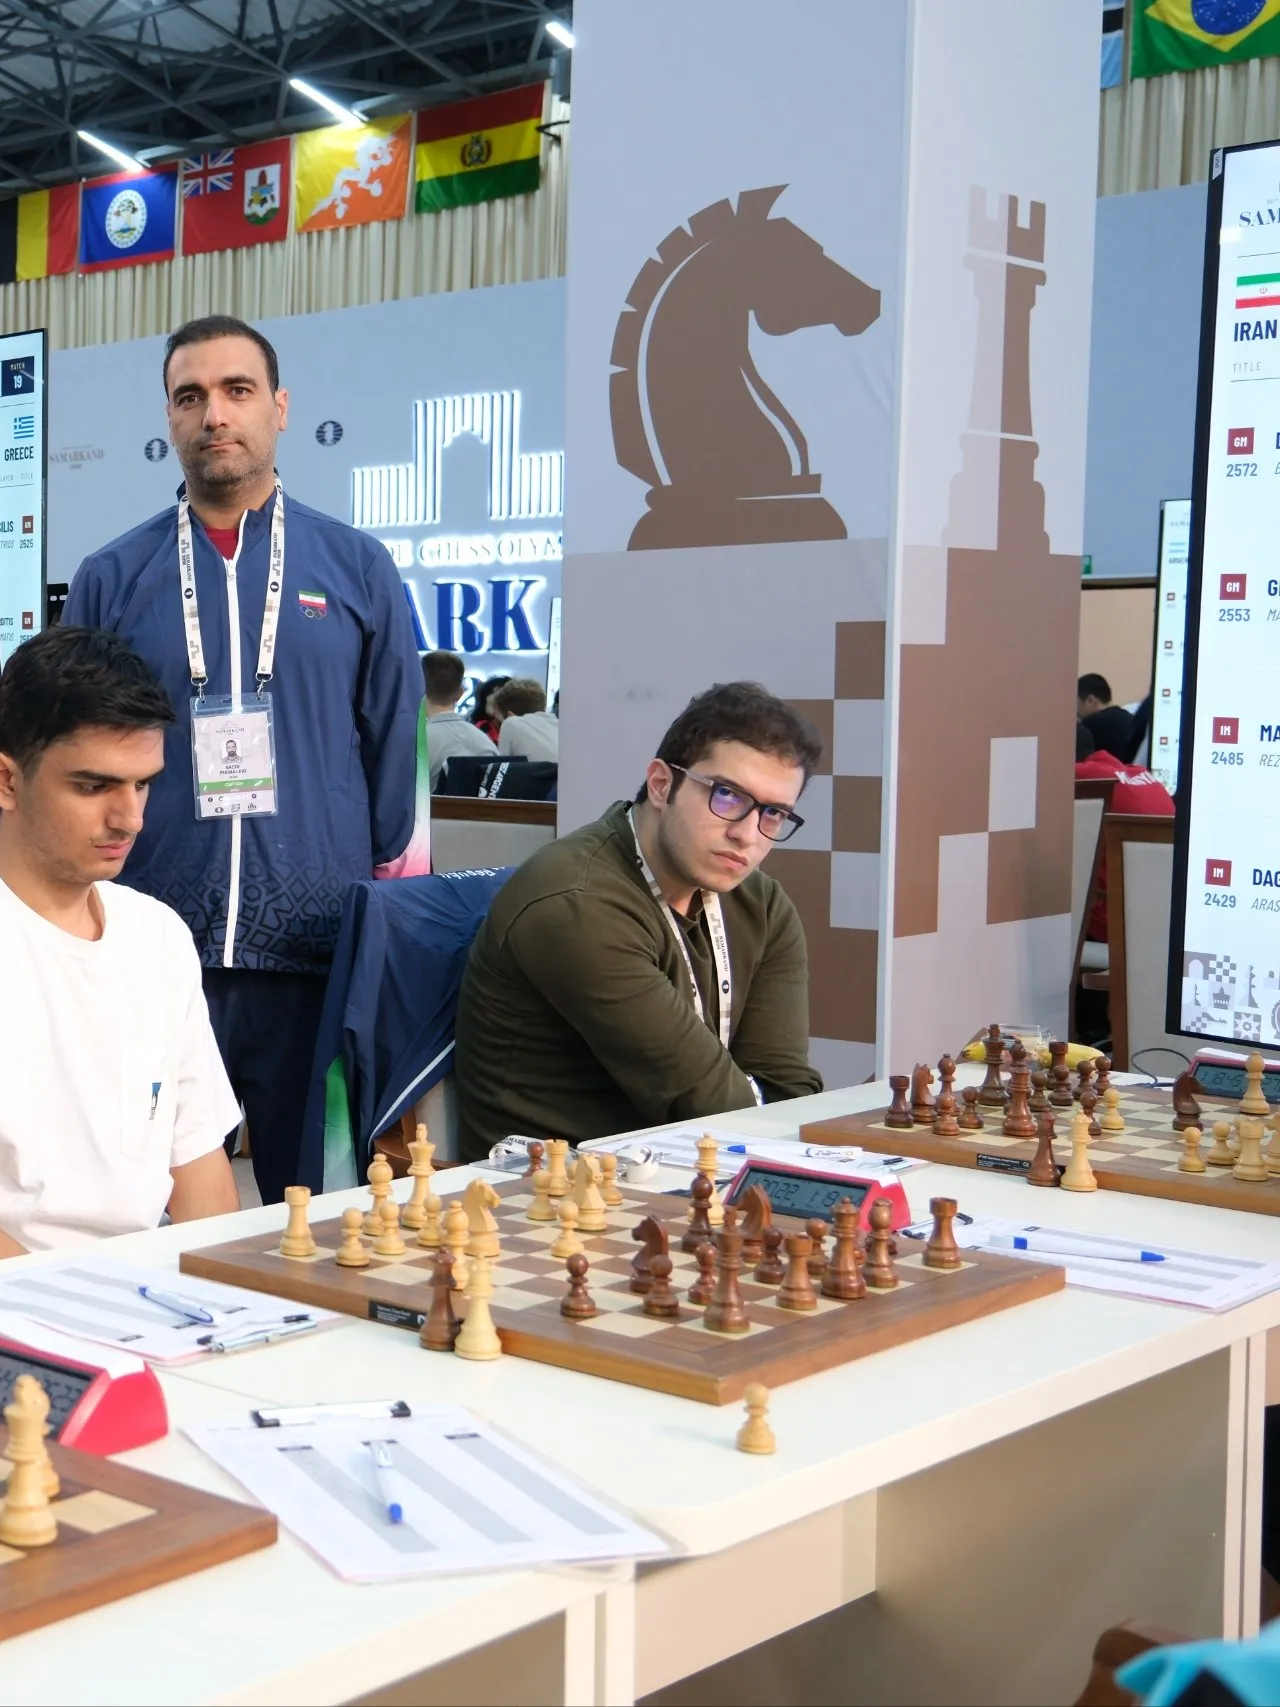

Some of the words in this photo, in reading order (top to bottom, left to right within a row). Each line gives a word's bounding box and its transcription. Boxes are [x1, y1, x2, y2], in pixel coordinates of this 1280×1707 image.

[1233, 319, 1278, 342] IRAN
[10, 362, 26, 371] MATCH
[1233, 361, 1262, 373] TITLE
[13, 375, 23, 389] 19
[1233, 436, 1248, 447] GM
[4, 446, 34, 462] GREECE
[1226, 462, 1258, 478] 2572
[1226, 582, 1240, 593] GM
[1219, 608, 1251, 622] 2553
[1220, 726, 1231, 736] IM
[1211, 751, 1244, 766] 2485
[1213, 867, 1224, 878] IM
[1204, 892, 1237, 908] 2429
[718, 935, 728, 972] SAMARKAND
